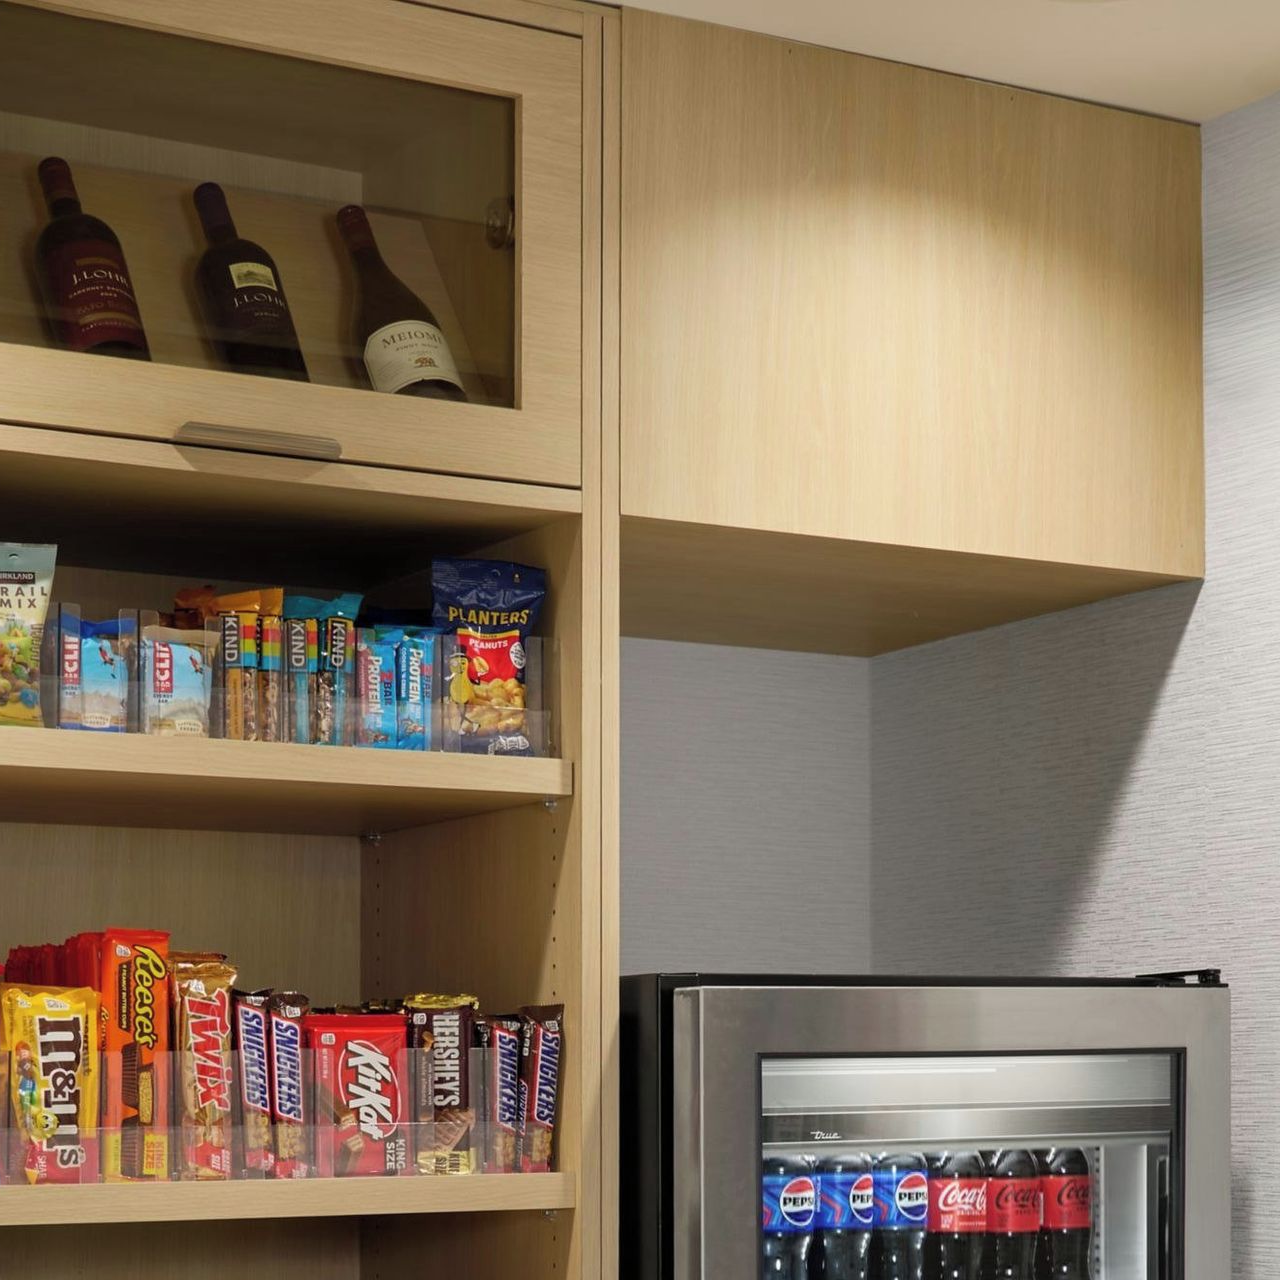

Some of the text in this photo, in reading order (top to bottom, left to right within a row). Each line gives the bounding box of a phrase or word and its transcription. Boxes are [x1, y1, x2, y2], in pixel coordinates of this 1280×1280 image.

[0, 599, 36, 608] MIX
[449, 606, 529, 624] PLANTERS
[225, 617, 238, 661] KIND
[291, 622, 305, 666] KIND
[332, 622, 344, 666] KIND
[469, 638, 508, 650] PEANUTS
[368, 656, 383, 714] PROTEIN
[410, 648, 423, 704] PROTEIN
[135, 945, 165, 1048] Reese's
[185, 988, 231, 1111] Twix
[274, 1019, 303, 1122] SNICKERS
[433, 1013, 460, 1108] HERSHEY'S
[496, 1032, 519, 1132] SNICKERS
[533, 1031, 559, 1126] SNICKERS
[386, 1142, 395, 1171] SIZE
[811, 1131, 842, 1140] True
